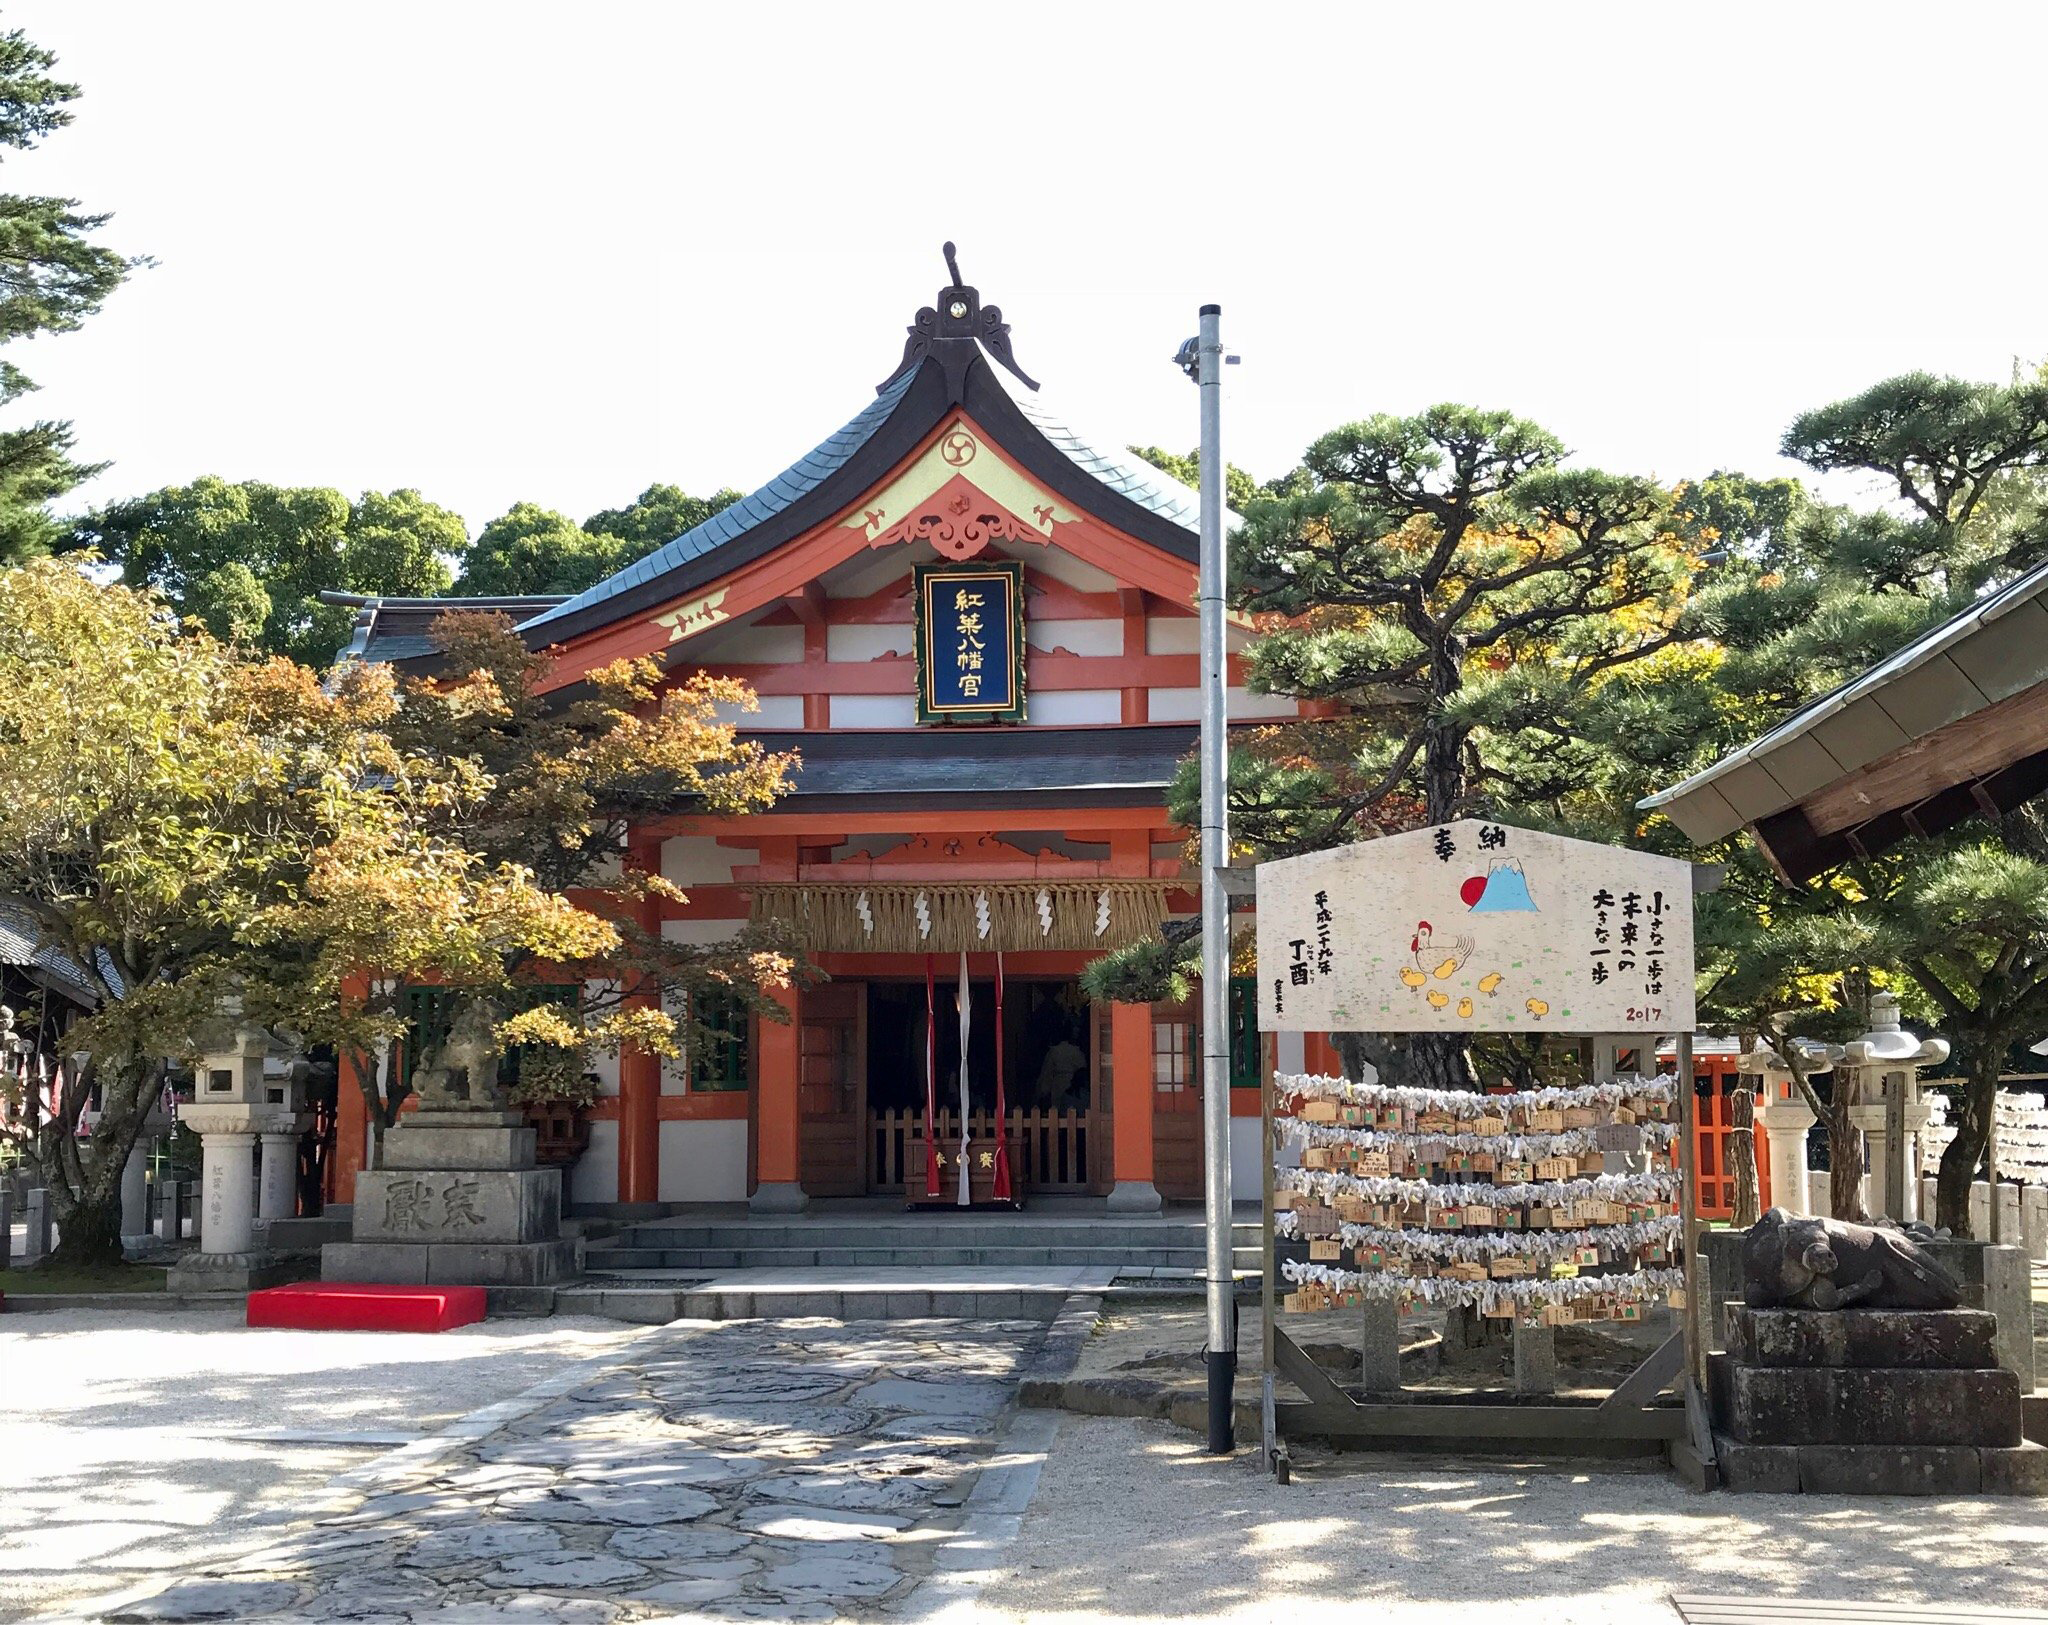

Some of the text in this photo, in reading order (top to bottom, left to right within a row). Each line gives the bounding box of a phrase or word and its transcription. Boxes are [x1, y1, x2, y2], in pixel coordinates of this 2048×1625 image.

[954, 589, 986, 697] 紅葉八幡宮
[1434, 825, 1506, 862] 奉納
[1289, 939, 1308, 986] 丁酉
[1314, 890, 1333, 975] 平成二十九年
[1590, 889, 1615, 985] 大きな一歩
[1645, 891, 1670, 994] 小さな一歩は
[1626, 1007, 1661, 1022] 2017
